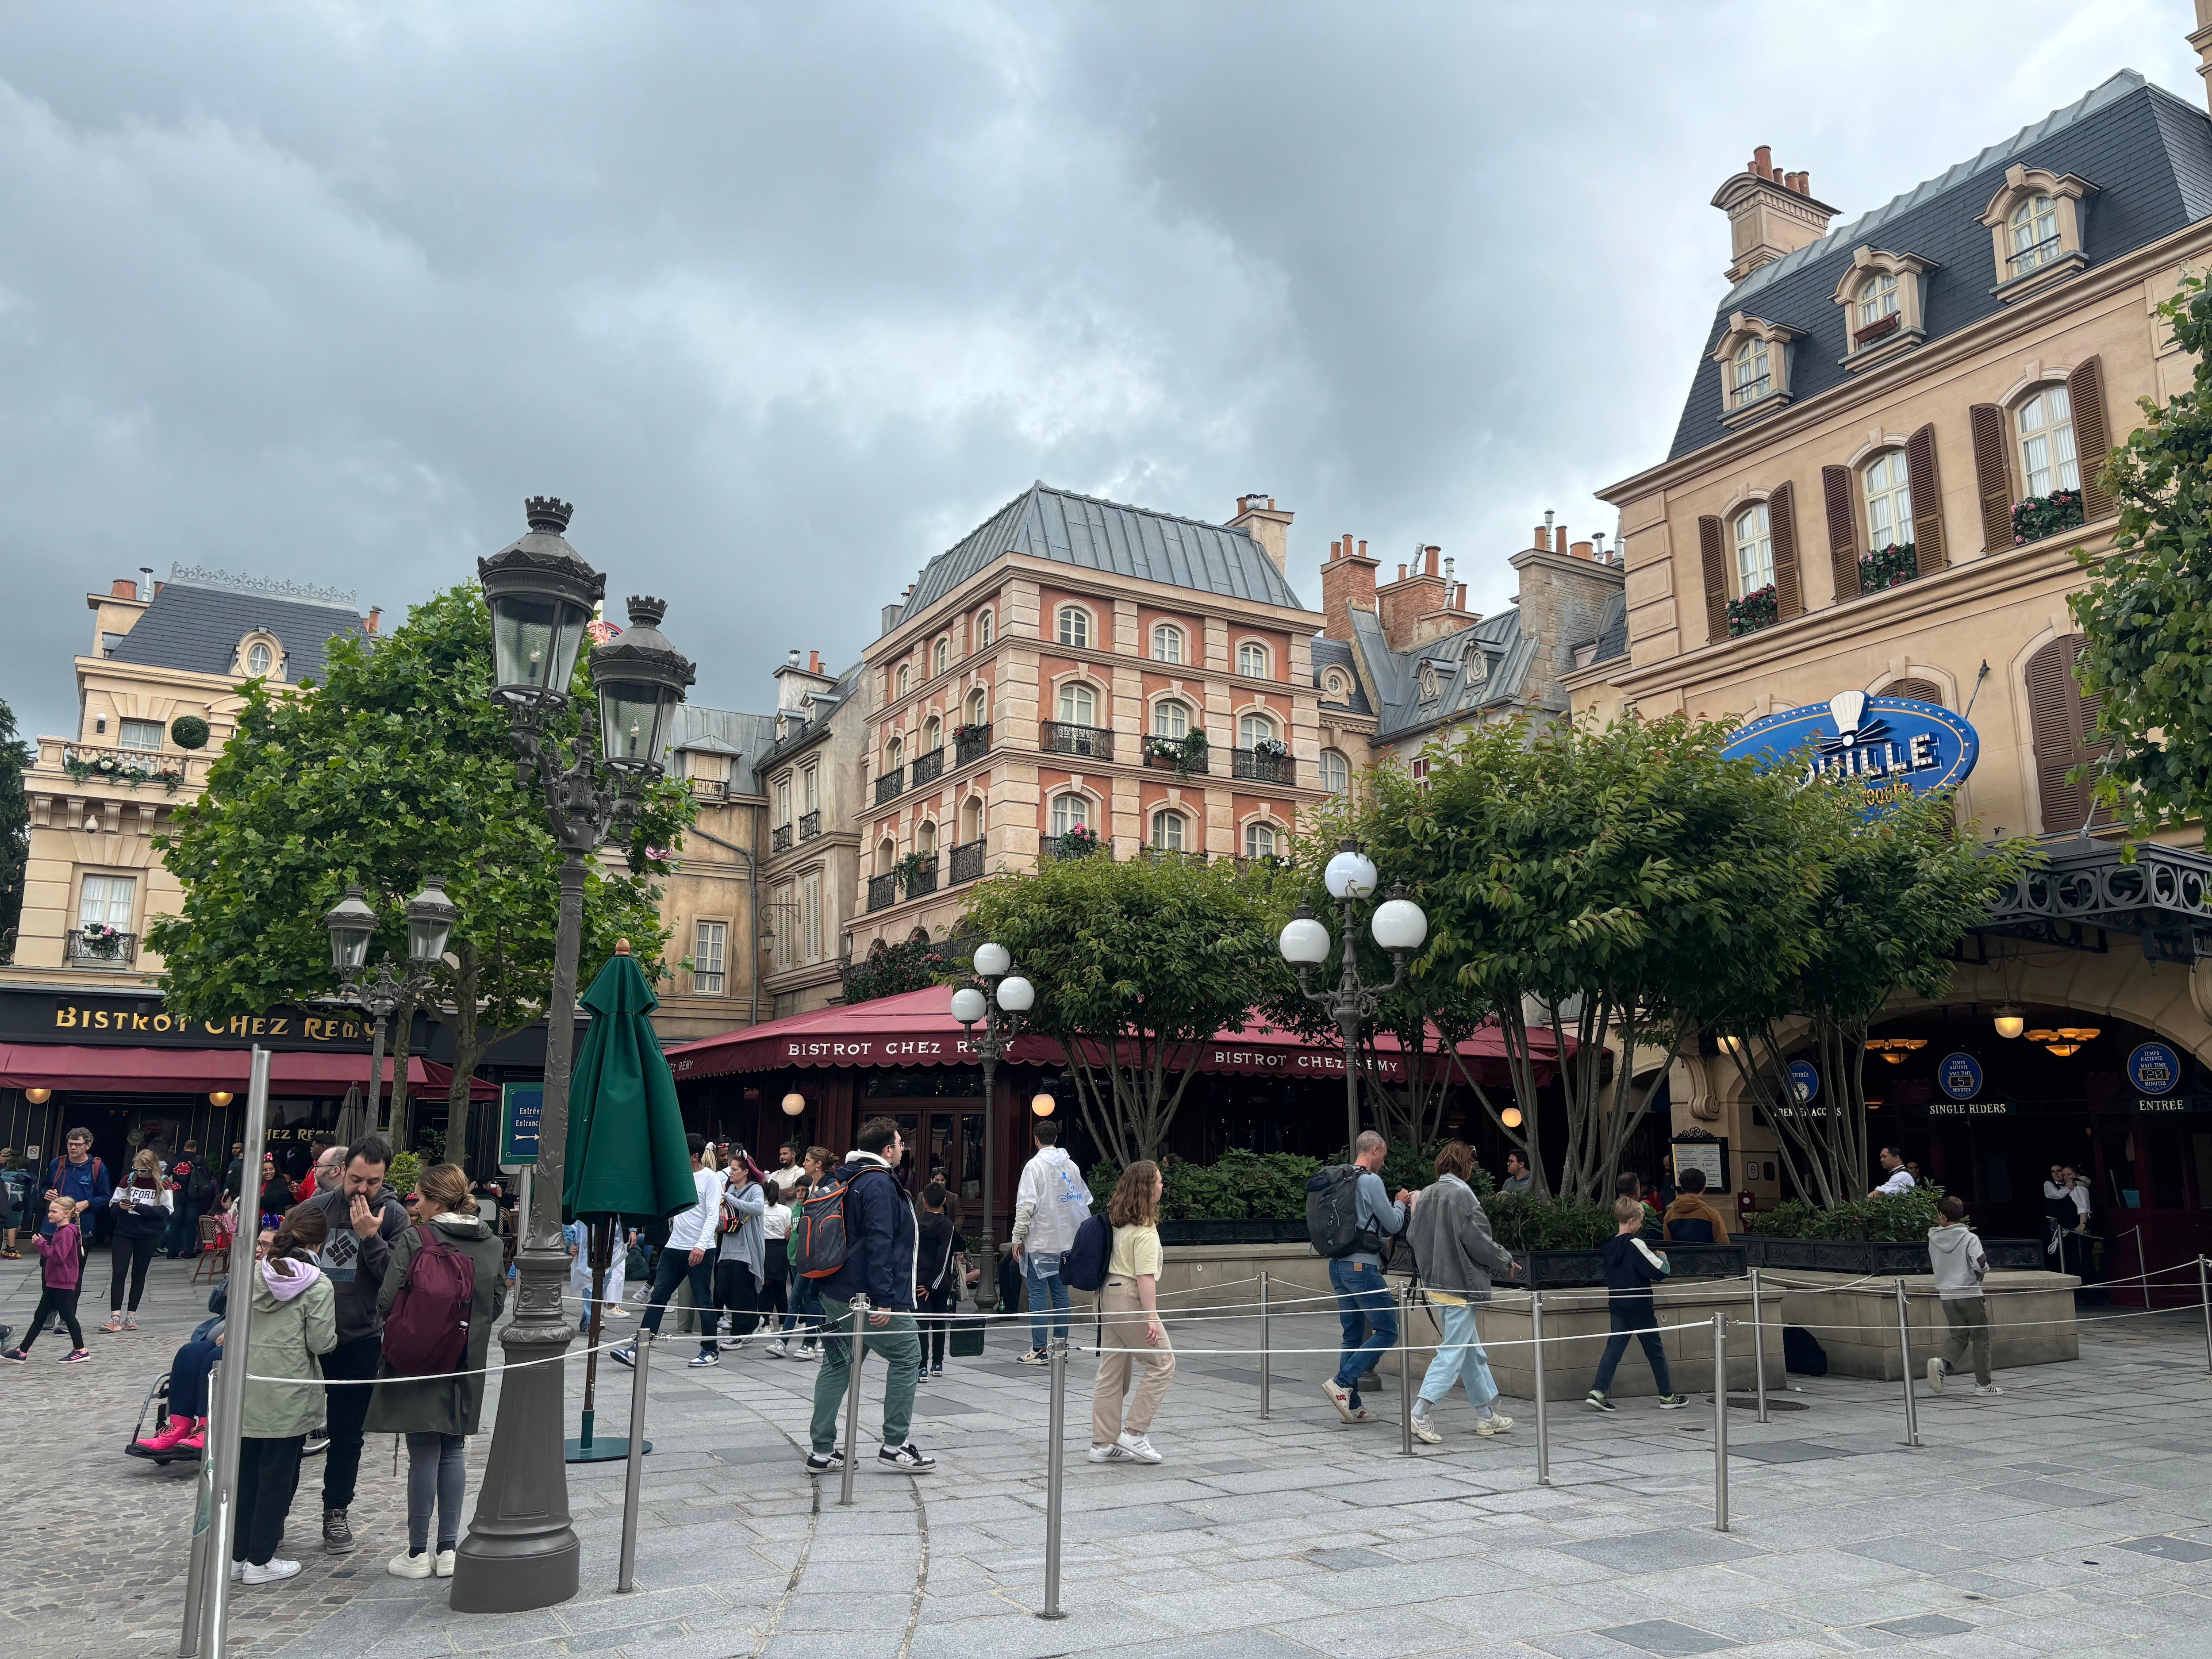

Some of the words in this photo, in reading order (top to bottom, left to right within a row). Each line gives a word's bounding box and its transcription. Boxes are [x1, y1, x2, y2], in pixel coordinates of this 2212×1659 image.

[54, 1006, 192, 1032] BISTROT
[205, 1015, 290, 1037] CHEZ
[787, 1042, 872, 1056] BISTROT
[885, 1041, 942, 1054] CHEZ
[956, 1037, 1015, 1053] RY
[678, 1057, 694, 1071] RÉMY
[1214, 1051, 1286, 1066] BISTROT
[1298, 1056, 1344, 1069] CHEZ
[1355, 1057, 1398, 1072] ÉMY
[2147, 1070, 2163, 1079] 20
[1958, 1077, 1964, 1086] 5
[1930, 1104, 1965, 1114] SINGLE
[1969, 1103, 2006, 1113] RIDERS
[2139, 1099, 2184, 1110] ENTRÉE
[1811, 1107, 1841, 1116] ACCS
[265, 1129, 291, 1141] HEZ
[130, 1188, 156, 1199] FORD
